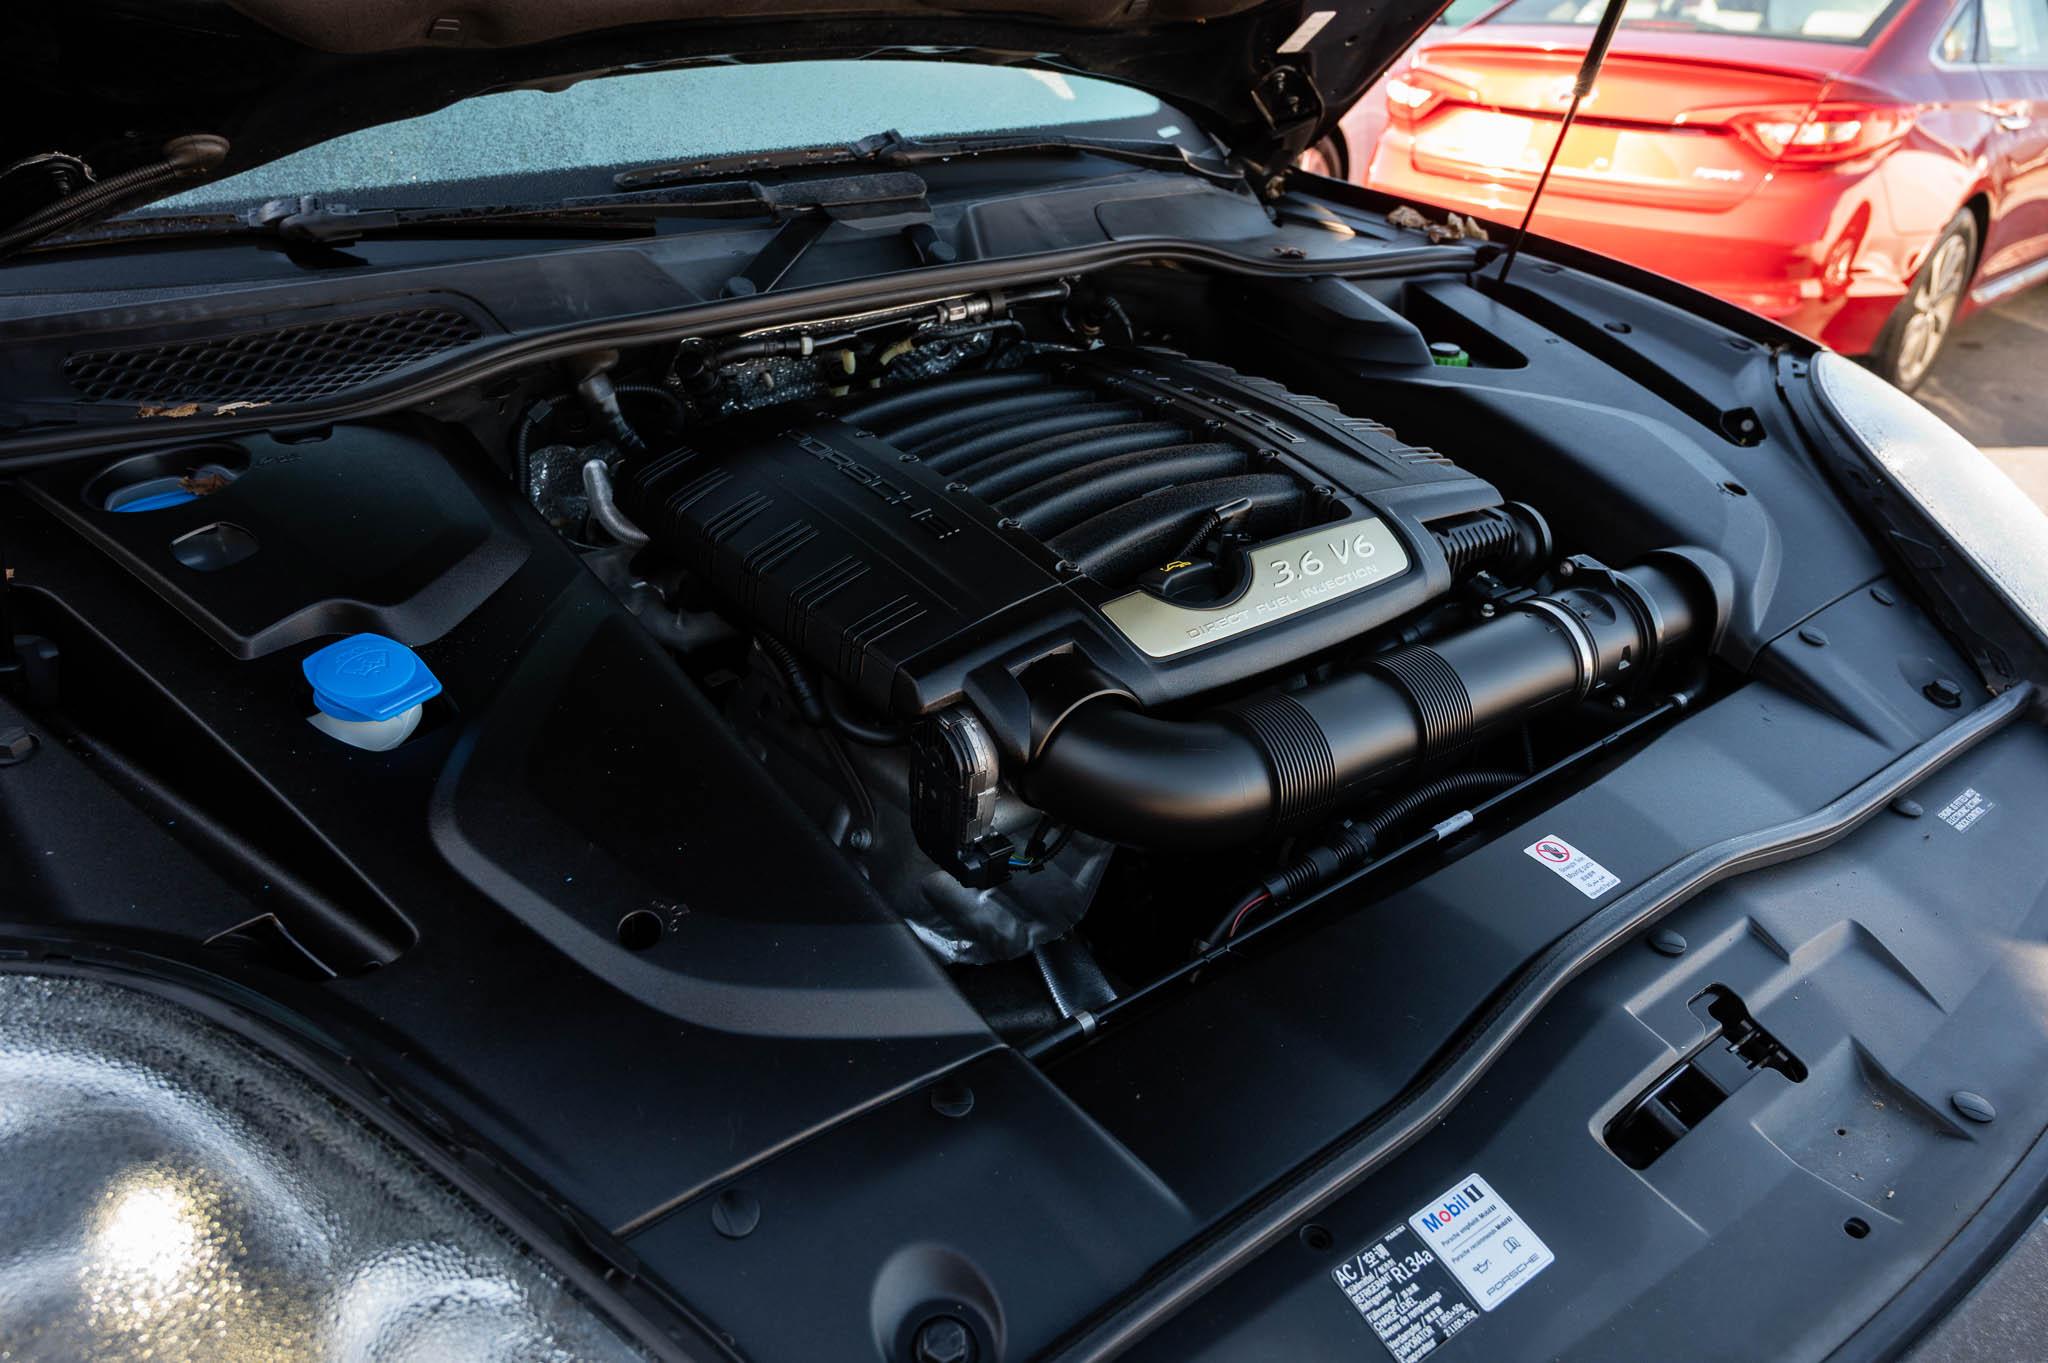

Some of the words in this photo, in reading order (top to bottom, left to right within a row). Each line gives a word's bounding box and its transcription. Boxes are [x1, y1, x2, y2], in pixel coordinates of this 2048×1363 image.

[1271, 549, 1324, 588] 3.6
[1328, 534, 1376, 566] V6
[1185, 608, 1250, 639] DIRECT
[1256, 595, 1299, 616] FUEL
[1301, 564, 1378, 600] INJECTION
[1421, 1192, 1469, 1233] Mobil
[1462, 1183, 1484, 1203] 1
[1440, 1230, 1460, 1247] Porsche
[1478, 1207, 1491, 1219] Mobil
[1389, 1249, 1434, 1283] R134a
[1450, 1246, 1470, 1263] Porsche
[1336, 1262, 1357, 1287] AC
[1351, 1271, 1392, 1305] REFRIGERANT
[1485, 1252, 1540, 1296] PORSCHE
[1372, 1308, 1400, 1331] CHARGE
[1395, 1295, 1418, 1314] LEVEL
[1394, 1324, 1435, 1358] EVAPORATOR
